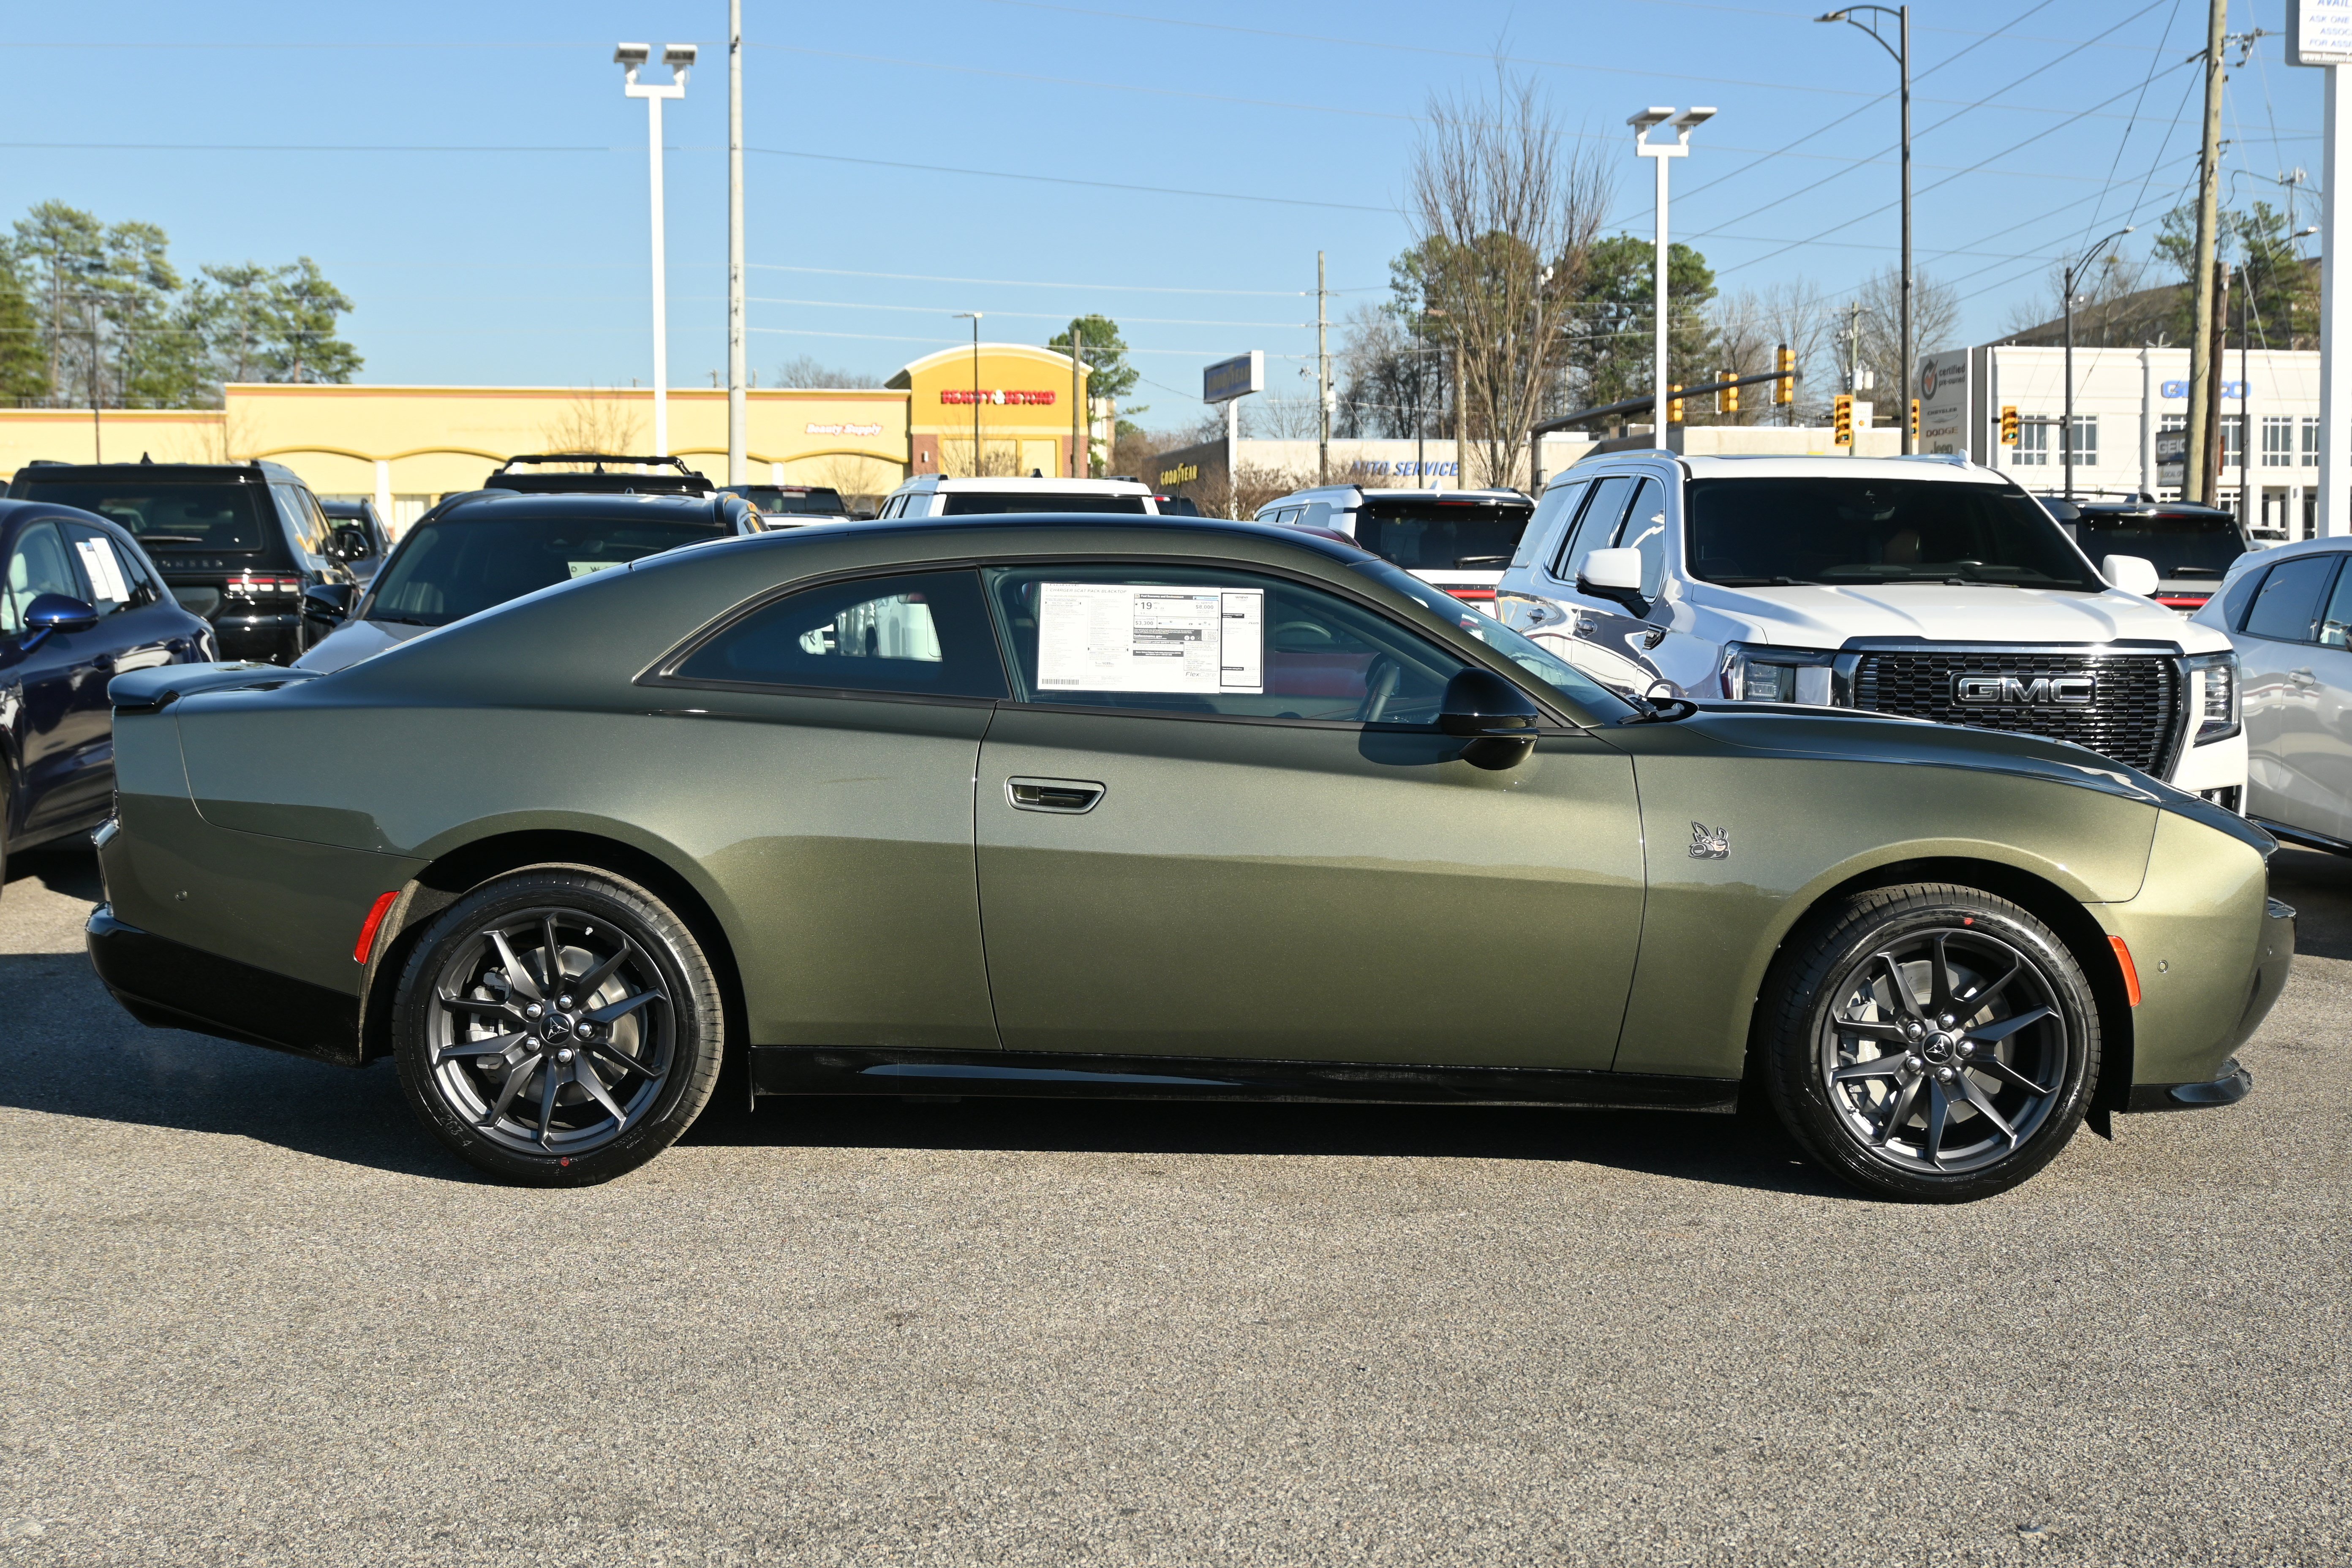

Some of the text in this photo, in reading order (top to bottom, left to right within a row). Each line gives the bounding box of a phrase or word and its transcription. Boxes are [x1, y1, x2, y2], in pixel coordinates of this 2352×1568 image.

[2330, 16, 2350, 24] ONE
[2320, 27, 2352, 36] ASSOC
[1939, 362, 1965, 376] certified
[1938, 375, 1965, 388] pre-owned
[1927, 407, 1957, 416] CHRYSLER
[805, 423, 883, 436] Beauty Supply
[1926, 426, 1959, 438] DODGE
[1930, 441, 1953, 454] Jeep
[2158, 439, 2186, 454] GEIC
[1161, 463, 1198, 487] GOODYEAR
[1958, 677, 2093, 702] GMC
[1930, 909, 2069, 982] EAGLE SPORT
